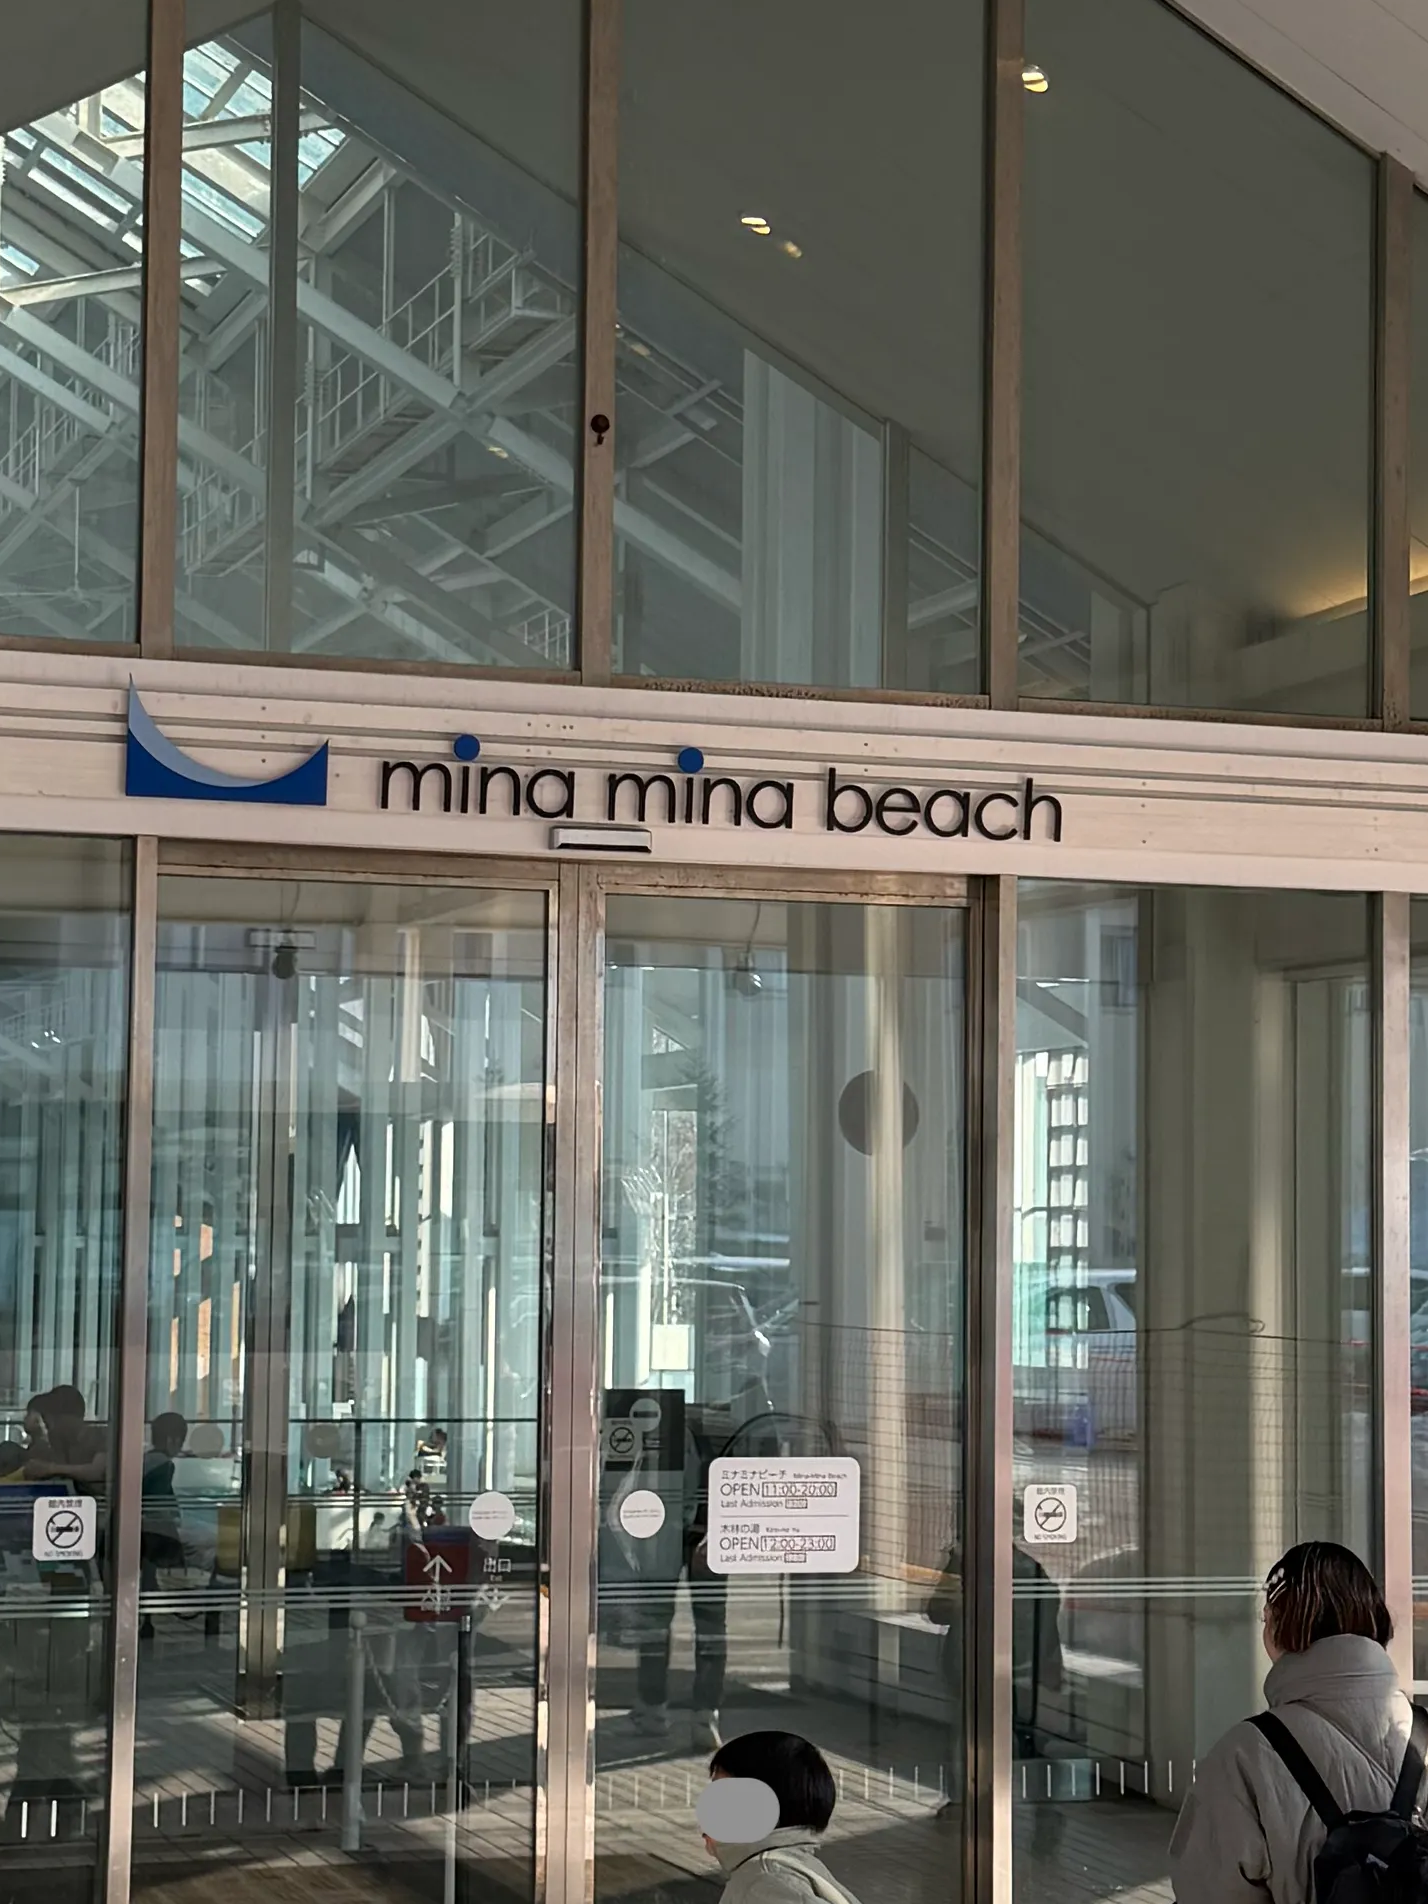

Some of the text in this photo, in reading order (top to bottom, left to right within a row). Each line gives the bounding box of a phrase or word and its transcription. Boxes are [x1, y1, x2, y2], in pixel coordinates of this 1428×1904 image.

[379, 733, 1063, 844] mina mina beach
[720, 1483, 760, 1496] OPEN
[721, 1499, 738, 1507] Last
[741, 1498, 784, 1508] Admission
[719, 1537, 760, 1550] OPEN
[739, 1553, 783, 1561] Admission
[483, 1556, 512, 1573] 出口
